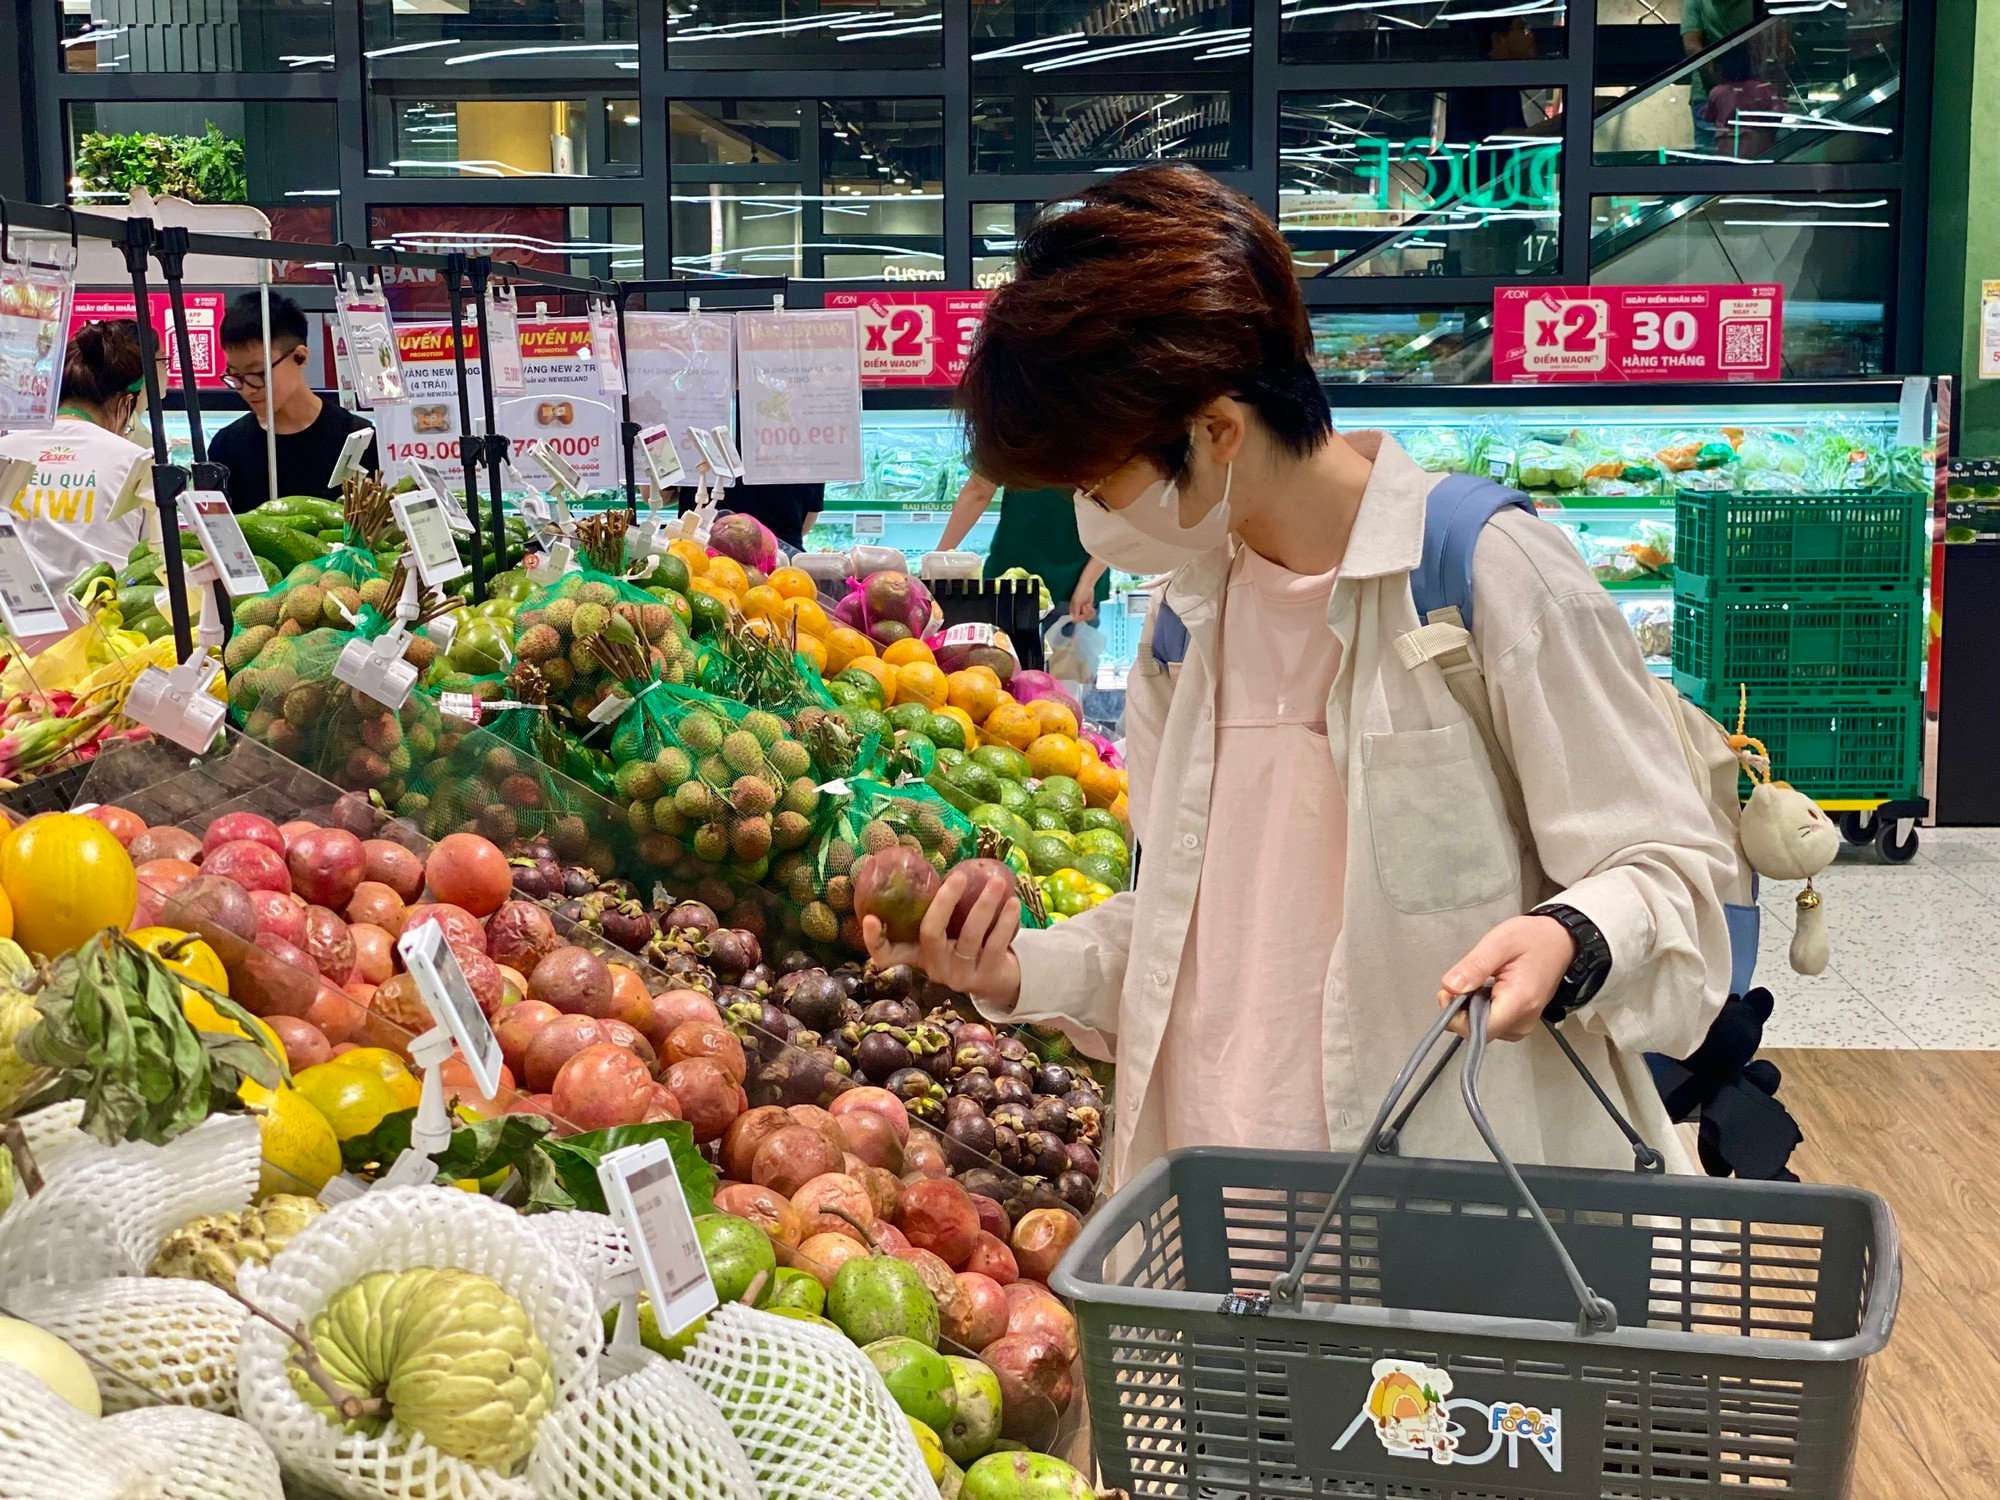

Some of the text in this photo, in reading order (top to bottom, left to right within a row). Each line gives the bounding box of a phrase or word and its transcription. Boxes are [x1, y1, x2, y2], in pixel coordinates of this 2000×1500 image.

[1632, 310, 1698, 351] 30
[1622, 353, 1706, 367] HÀNG THÁNG
[432, 368, 454, 376] NEW
[551, 365, 573, 373] NEW
[575, 364, 581, 372] 2
[584, 363, 597, 372] TR
[426, 390, 459, 398] NEWZELA
[38, 450, 79, 463] Zespri
[387, 440, 462, 461] 149.00
[60, 470, 96, 487] QUẢ
[902, 503, 920, 511] RAU
[1492, 1406, 1558, 1445] FOCUS
